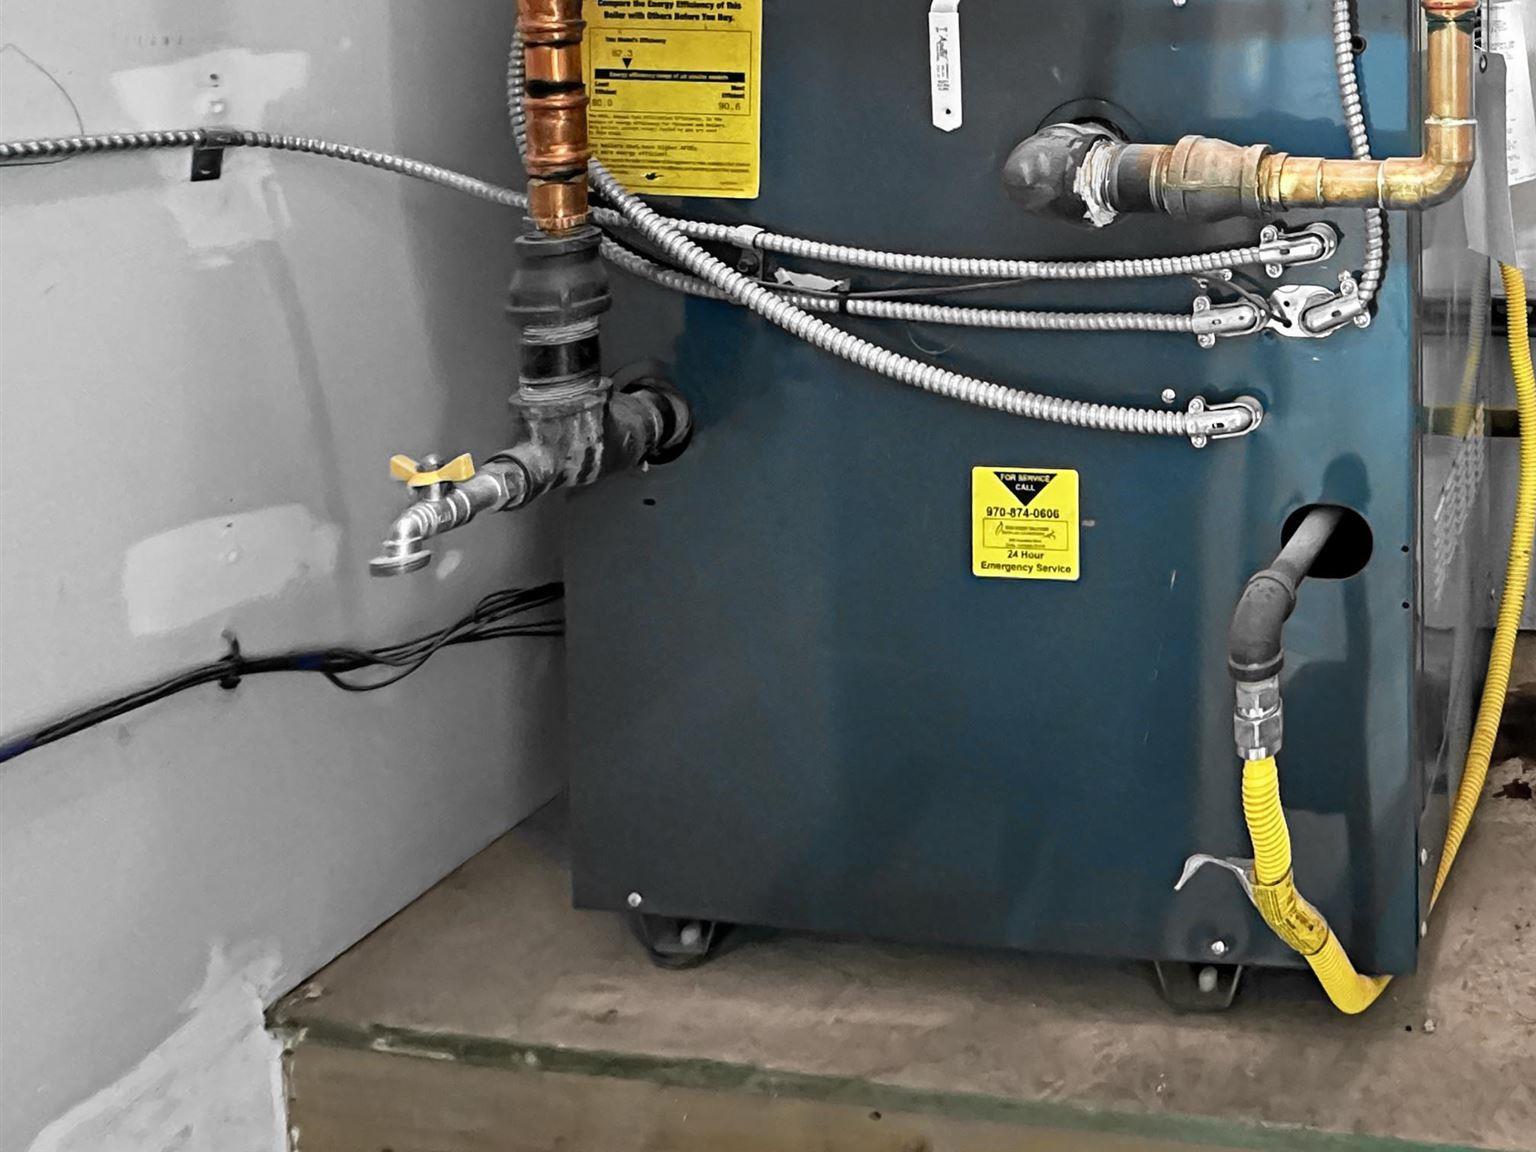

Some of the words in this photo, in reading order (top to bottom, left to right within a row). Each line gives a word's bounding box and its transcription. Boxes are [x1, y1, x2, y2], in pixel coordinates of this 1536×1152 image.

[1000, 473, 1016, 481] FOR
[1018, 474, 1050, 483] SERVICE
[1015, 483, 1035, 491] CALL
[986, 506, 1060, 519] 970-874-0606
[1007, 550, 1018, 559] 24
[1021, 551, 1044, 560] Hour
[981, 560, 1033, 574] Emergency
[1036, 563, 1071, 573] Service
